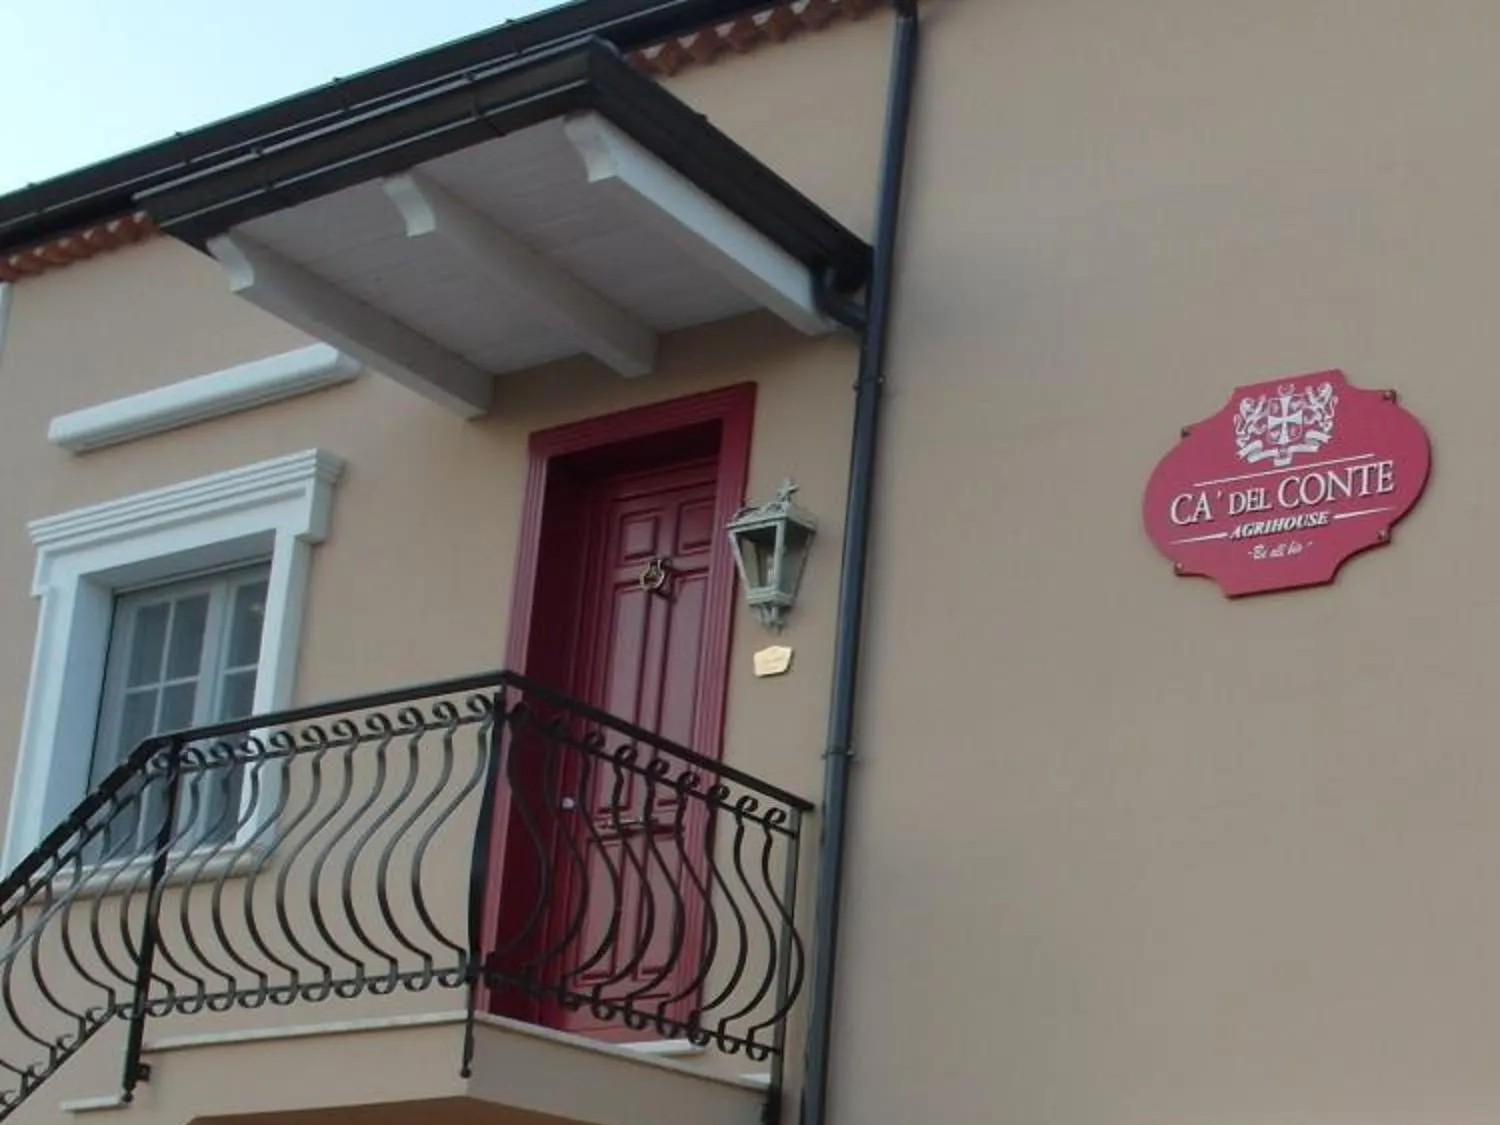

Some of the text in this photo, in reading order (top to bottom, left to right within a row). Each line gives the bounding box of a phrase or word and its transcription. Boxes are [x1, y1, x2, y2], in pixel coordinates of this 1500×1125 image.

[1228, 487, 1272, 515] DEL
[1277, 460, 1394, 508] CONTE
[1229, 511, 1330, 540] AGRIHOUSE
